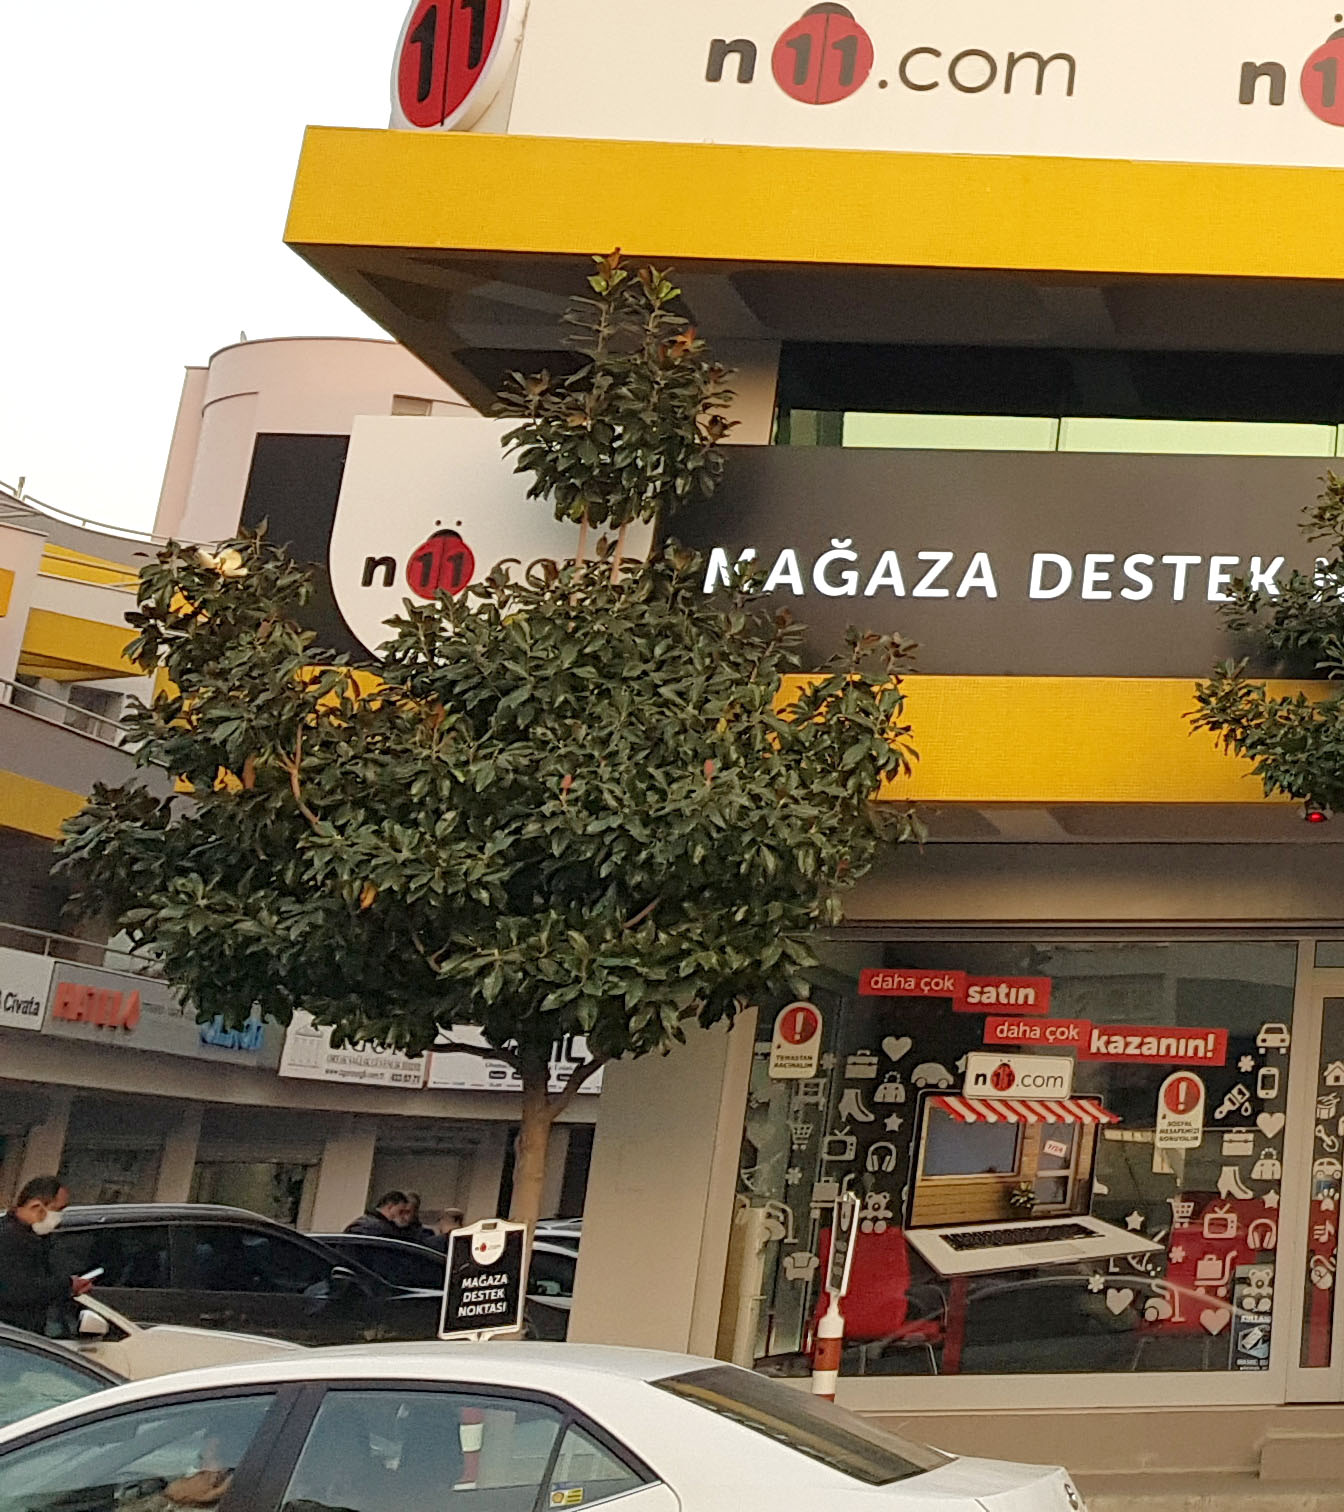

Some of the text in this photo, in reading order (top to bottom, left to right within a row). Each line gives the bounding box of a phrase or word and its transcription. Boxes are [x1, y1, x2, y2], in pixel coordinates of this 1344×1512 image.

[704, 26, 1077, 102] n11.com
[702, 537, 998, 599] MAĞAZA
[1028, 553, 1286, 603] DESTEK
[870, 973, 955, 994] daha çok
[967, 982, 1036, 1006] satın
[995, 1022, 1080, 1043] daha çok
[1090, 1029, 1216, 1058] kazanın!
[461, 1272, 509, 1289] MAĞAZA
[462, 1288, 506, 1303] DESTEK
[457, 1301, 508, 1318] NOKTASI
